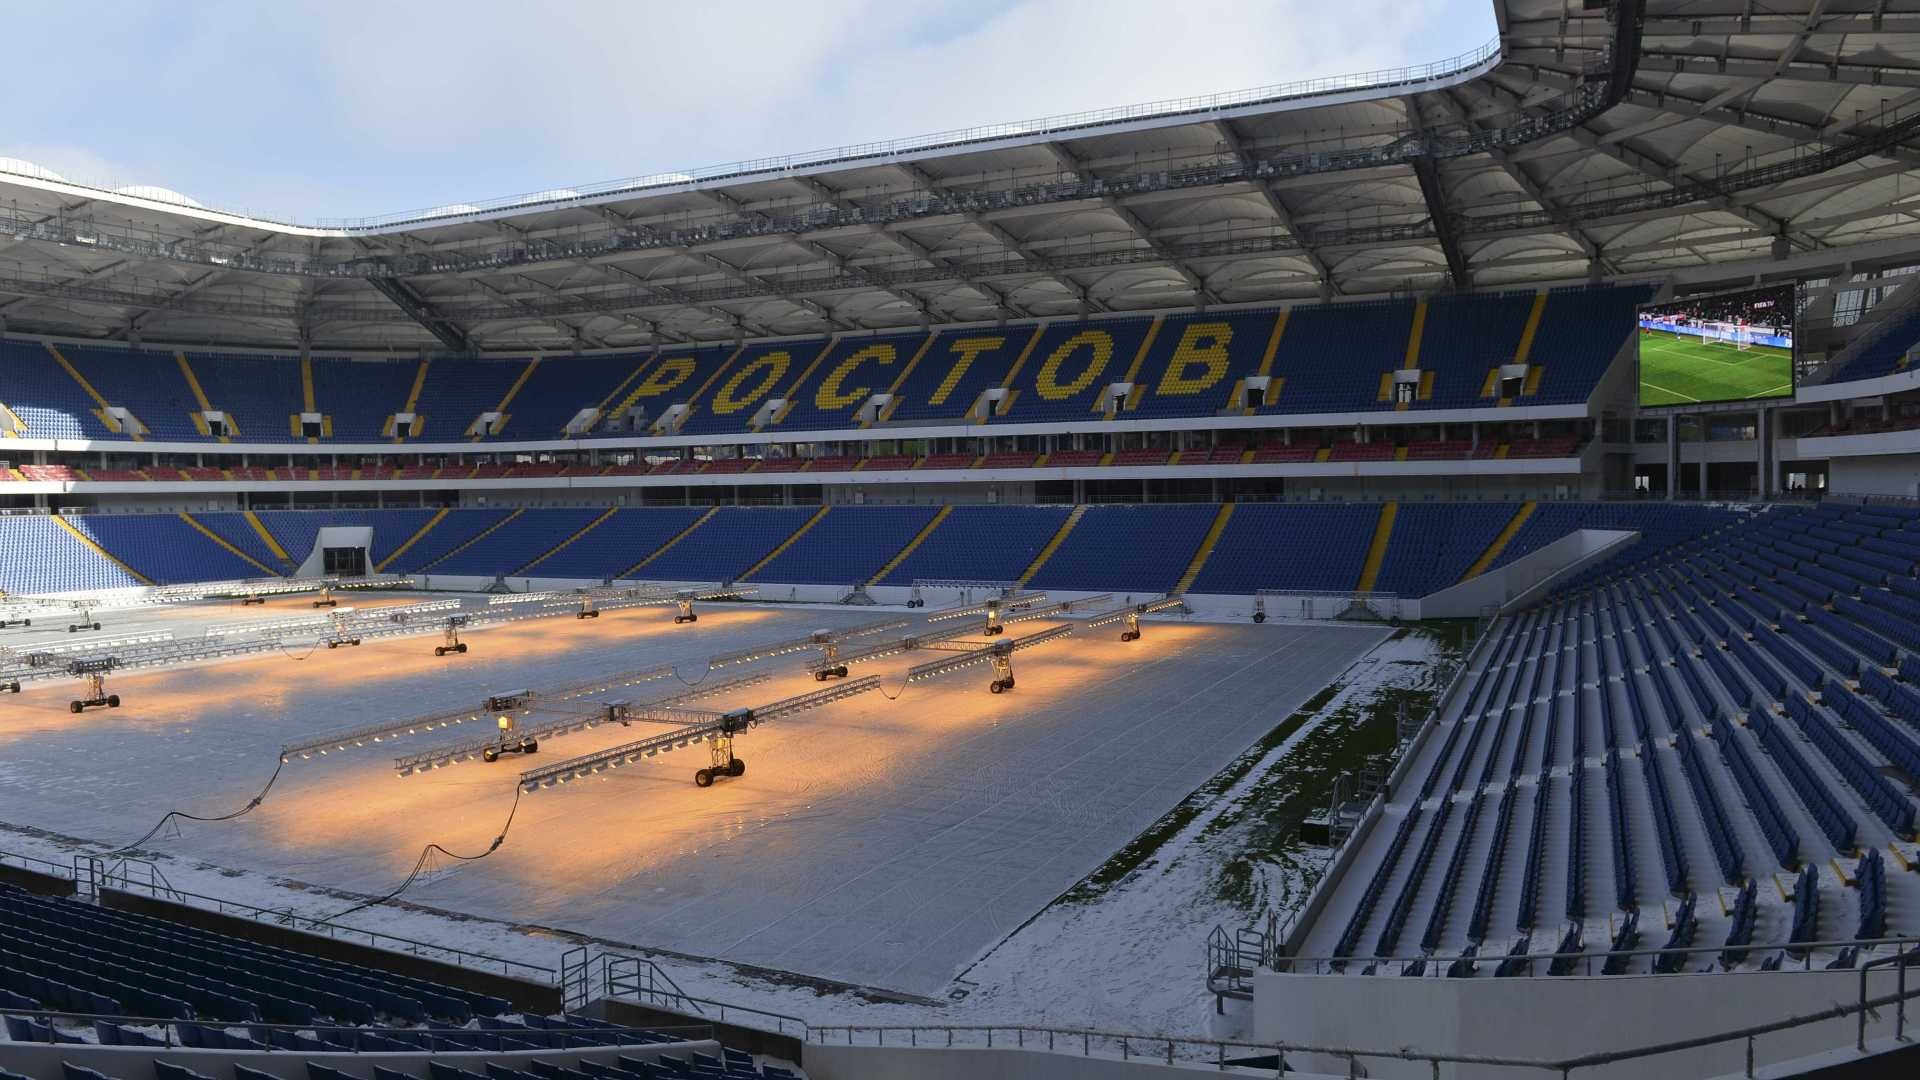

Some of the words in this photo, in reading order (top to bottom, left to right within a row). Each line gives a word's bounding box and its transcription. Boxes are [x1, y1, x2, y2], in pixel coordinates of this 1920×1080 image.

[1754, 301, 1767, 309] FIFA
[1766, 299, 1775, 307] TV
[607, 322, 1234, 420] РОСТОВ
